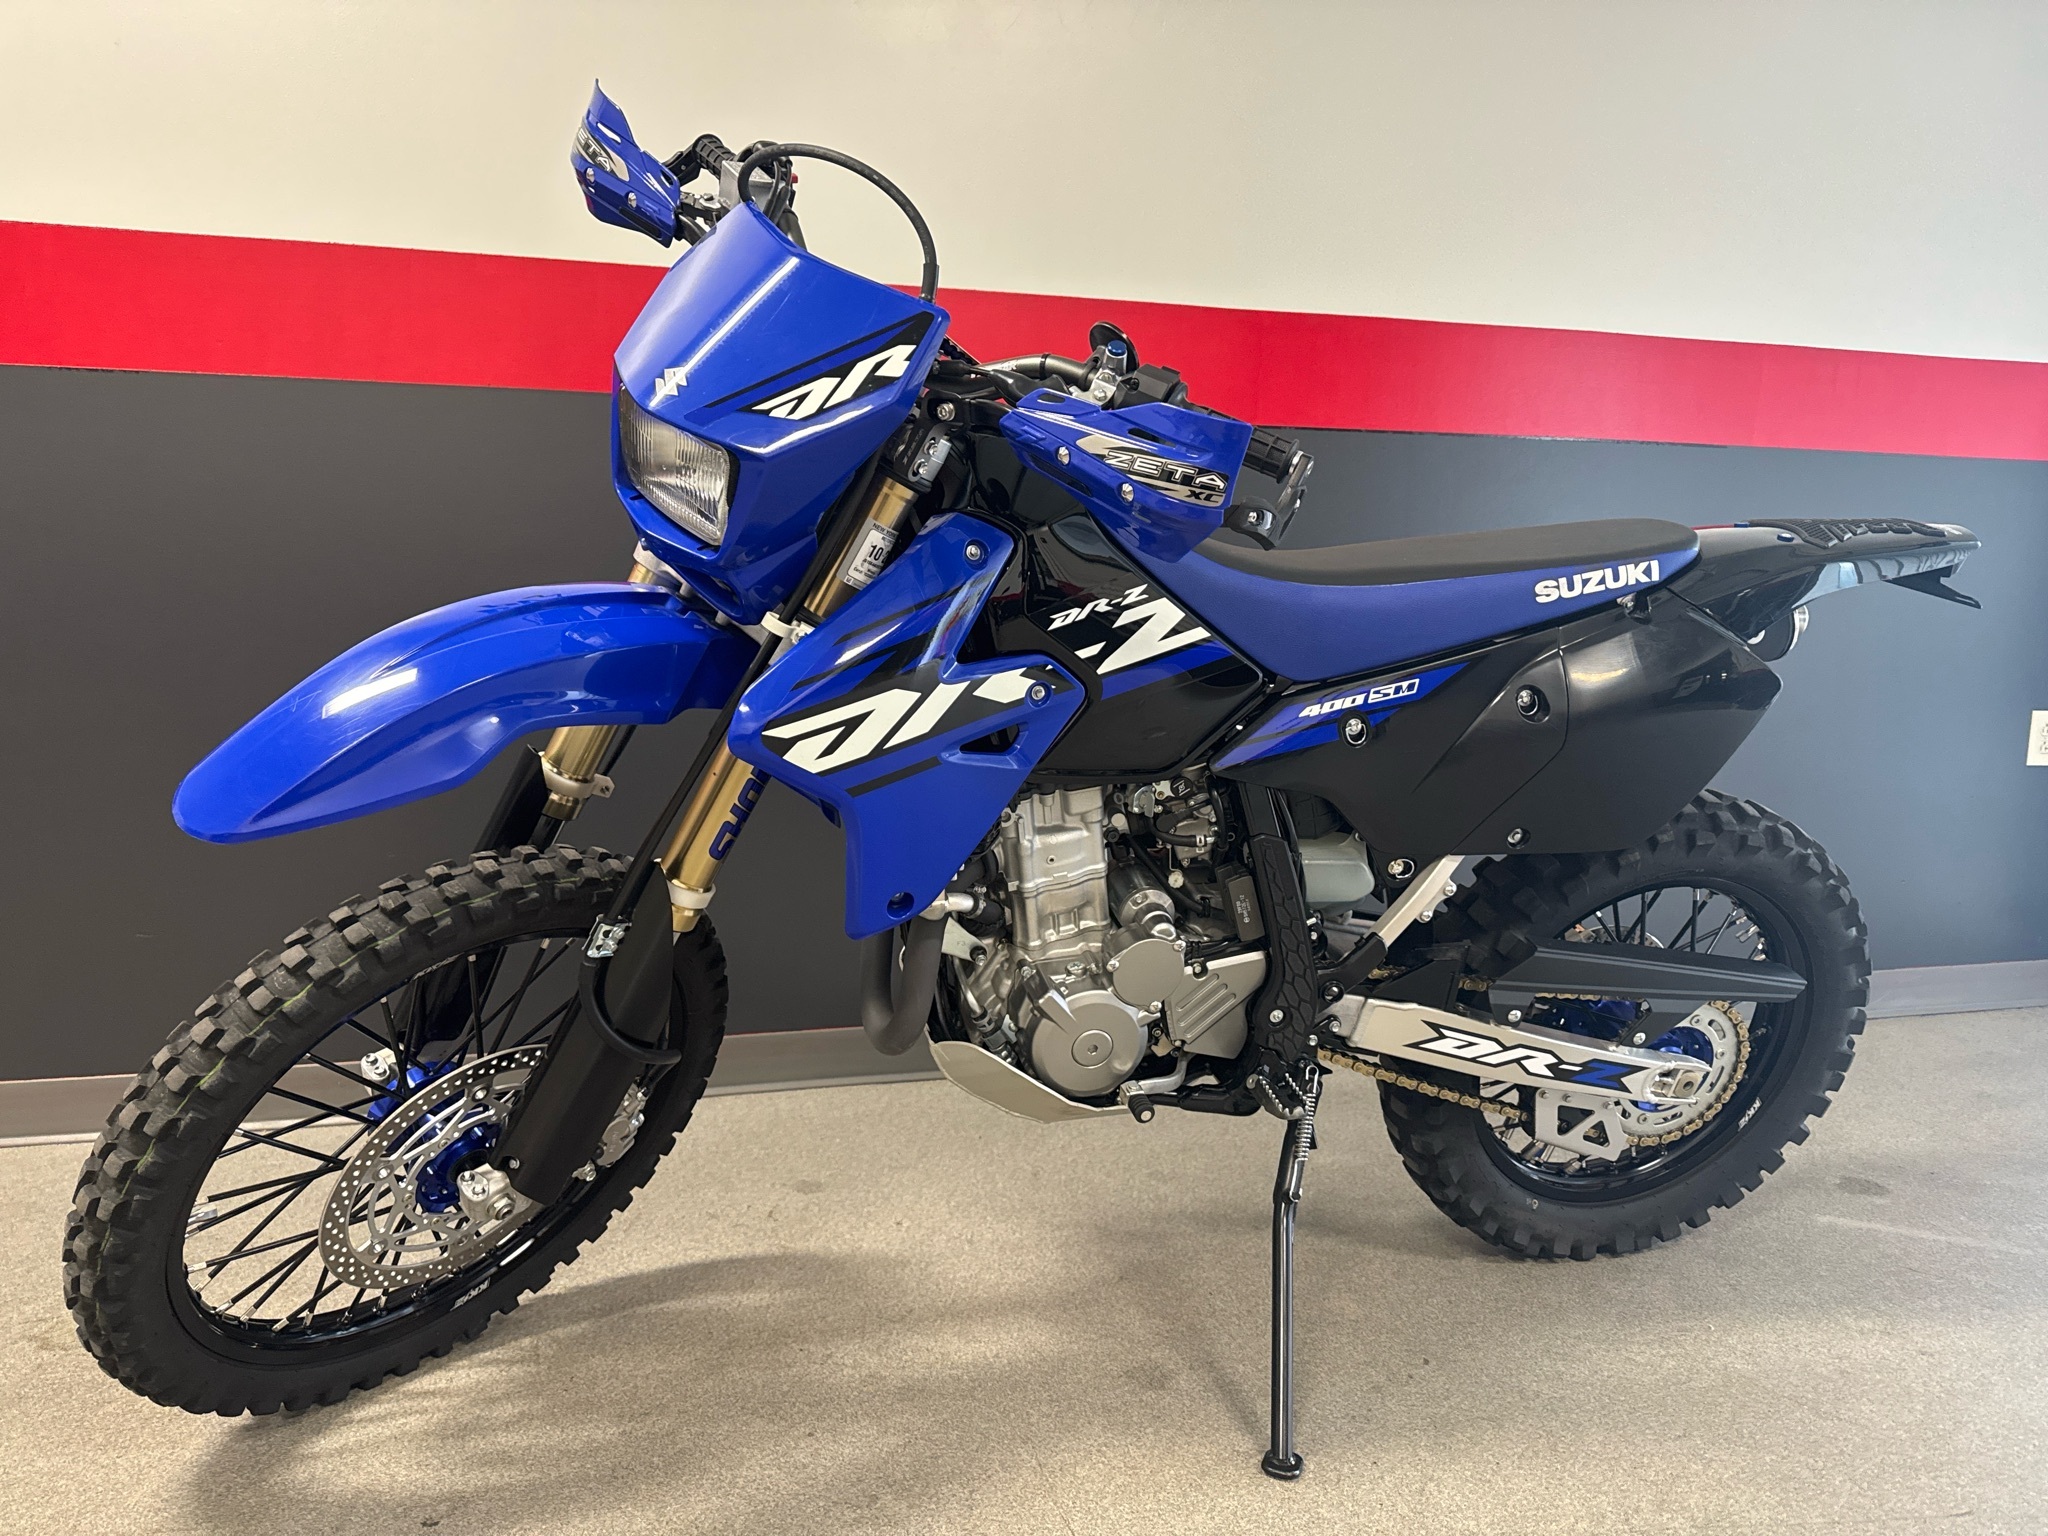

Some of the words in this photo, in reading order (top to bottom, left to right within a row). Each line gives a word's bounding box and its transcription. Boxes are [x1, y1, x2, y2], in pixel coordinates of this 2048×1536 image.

[576, 127, 611, 173] ETA
[1103, 450, 1228, 492] ZETA
[1534, 559, 1660, 604] SUZUKI
[1047, 583, 1149, 631] DR-Z
[1299, 693, 1368, 717] 400
[1368, 679, 1420, 703] SM
[708, 766, 772, 861] SHO
[1418, 1027, 1631, 1089] DR-Z
